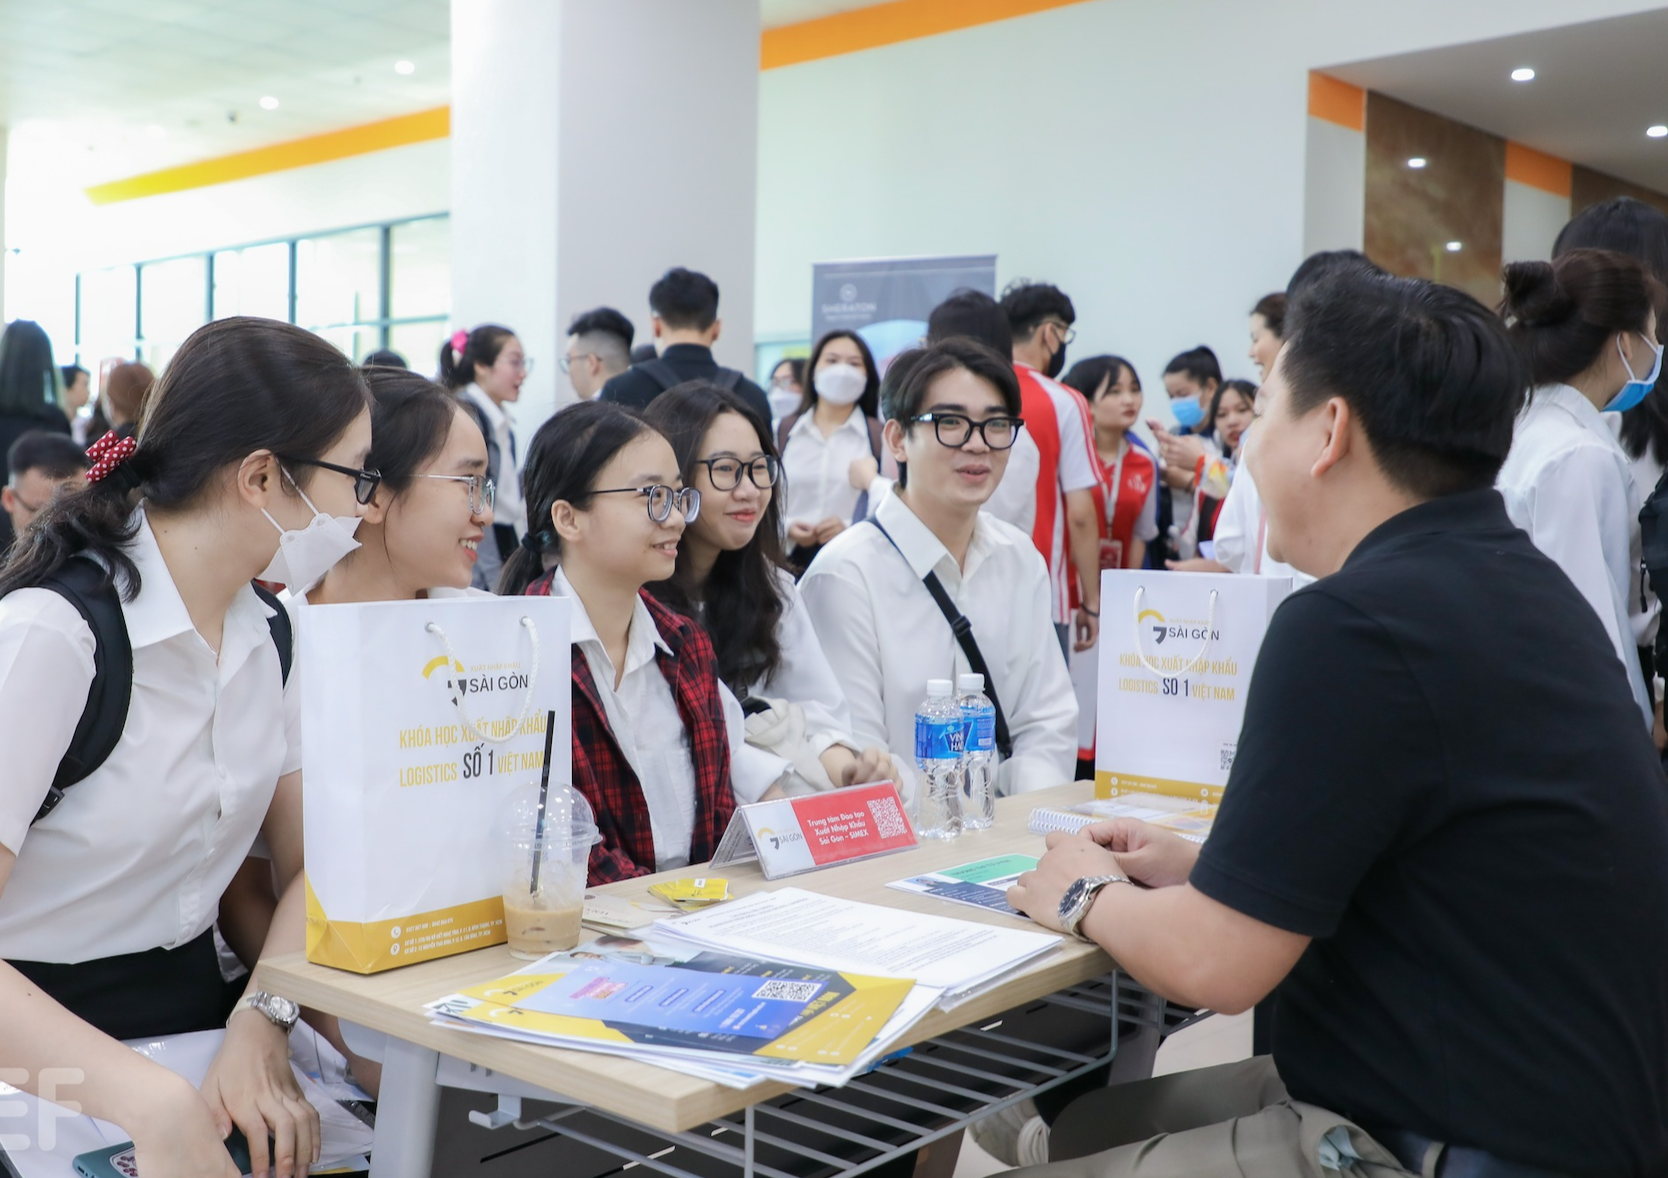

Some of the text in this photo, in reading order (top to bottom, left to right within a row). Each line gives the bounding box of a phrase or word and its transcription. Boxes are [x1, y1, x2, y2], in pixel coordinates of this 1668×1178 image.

[1169, 625, 1188, 638] SÀI
[1212, 656, 1237, 676] KHẨU
[469, 671, 528, 693] SÀI GÒN
[1119, 678, 1158, 694] LOGISTICS
[1184, 679, 1189, 697] 1
[1214, 686, 1235, 701] NAM
[399, 723, 432, 748] KHÓA
[435, 725, 458, 748] HỌC
[400, 743, 544, 787] LOGISTICS SỐ 1 VIỆT NAM
[807, 818, 828, 827] Trung
